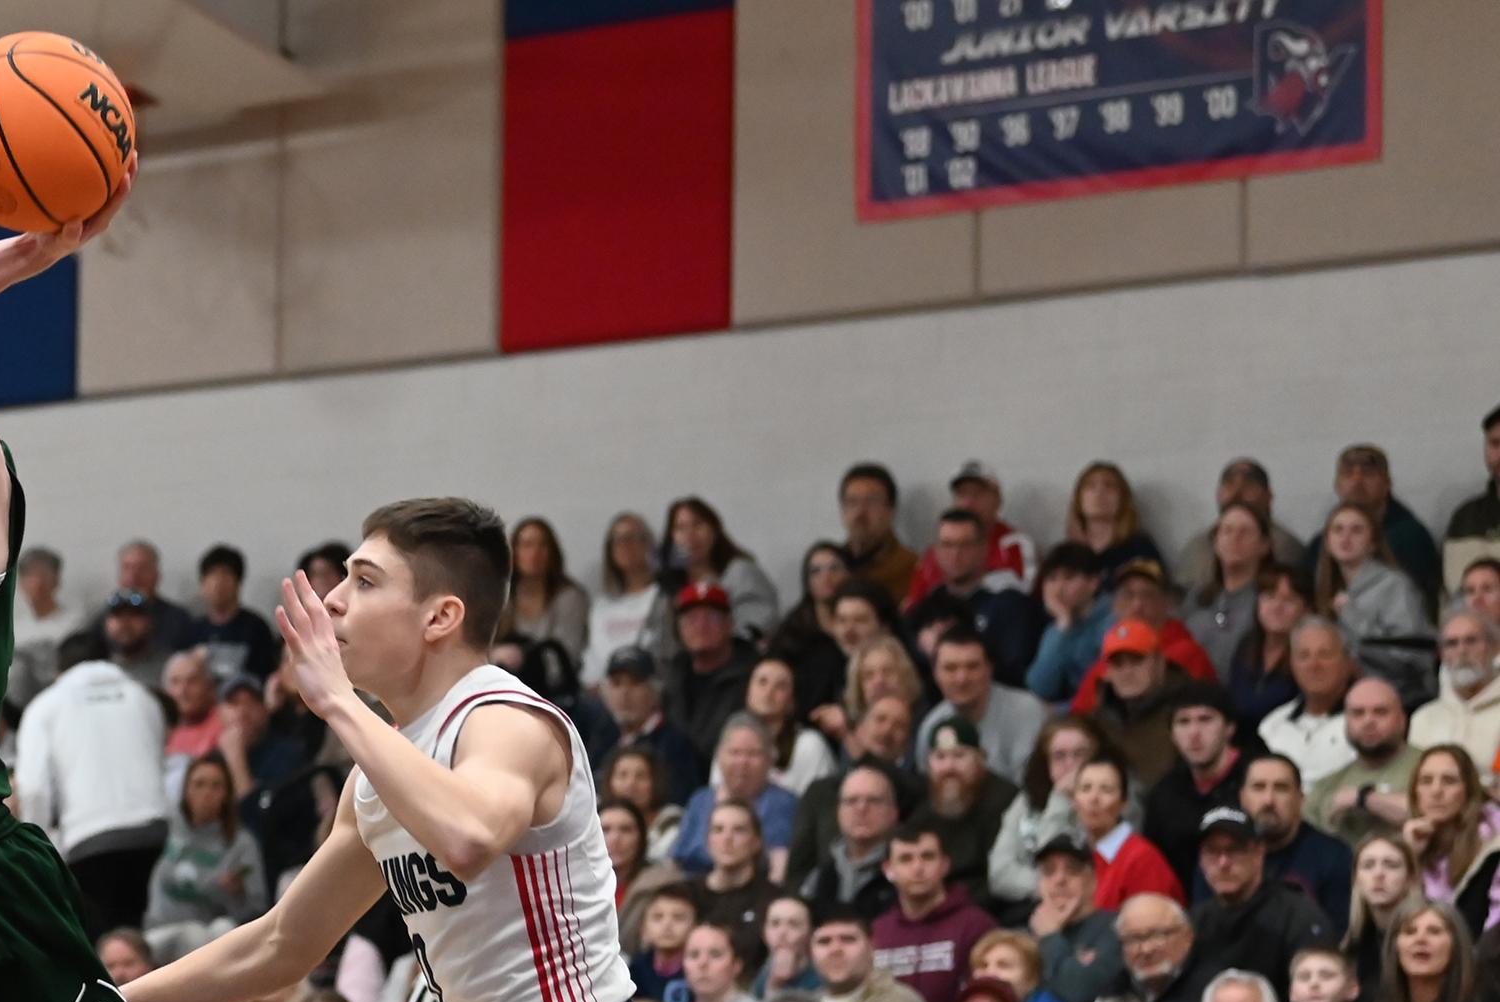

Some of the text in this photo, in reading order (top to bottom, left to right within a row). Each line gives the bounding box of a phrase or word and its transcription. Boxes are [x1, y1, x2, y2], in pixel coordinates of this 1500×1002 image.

[940, 14, 1092, 65] JUNIOR
[1025, 53, 1097, 95] LEAGUE
[80, 82, 132, 164] NCAA
[1047, 105, 1081, 141] '97
[1202, 84, 1237, 121] '00
